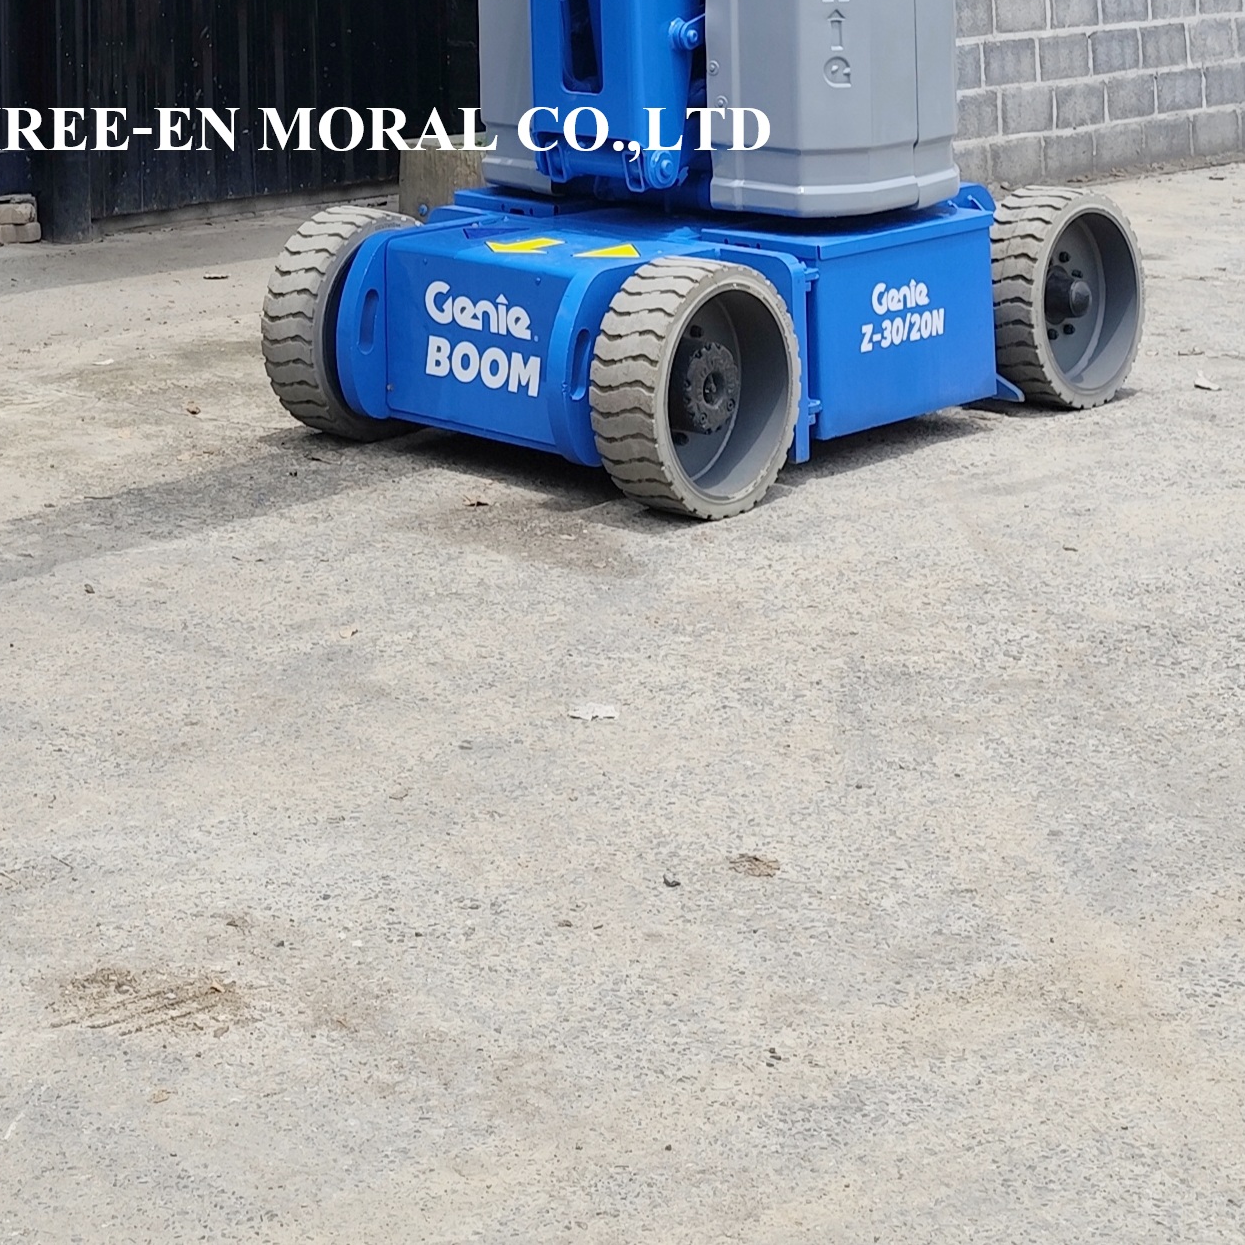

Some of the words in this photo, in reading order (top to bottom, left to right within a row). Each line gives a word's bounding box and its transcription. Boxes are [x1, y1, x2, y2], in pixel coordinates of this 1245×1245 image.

[425, 281, 533, 341] Genie
[871, 278, 931, 315] Genie
[860, 307, 945, 353] Z-30/20N
[425, 335, 541, 397] BOOM
